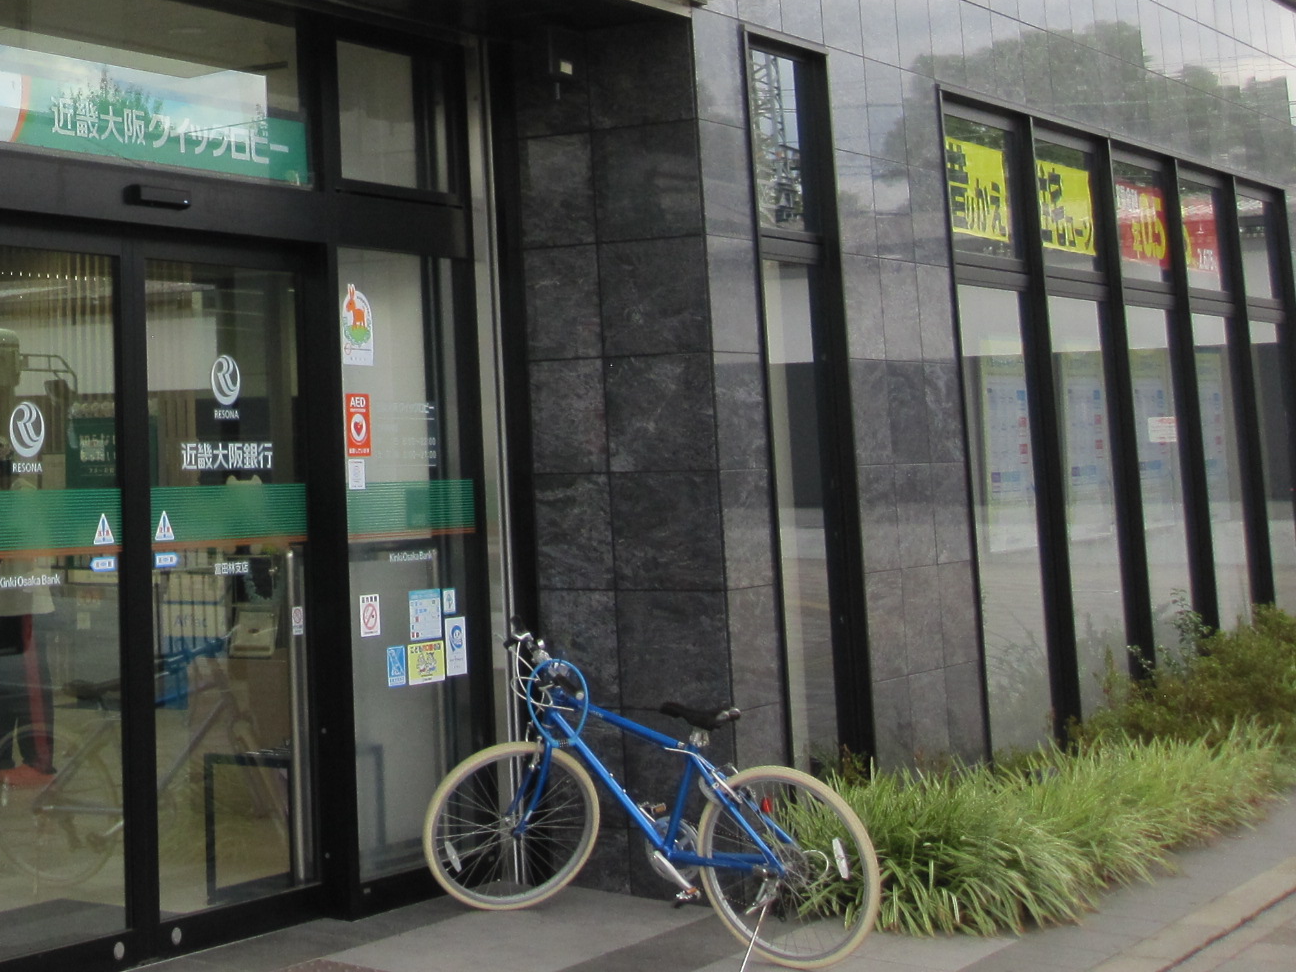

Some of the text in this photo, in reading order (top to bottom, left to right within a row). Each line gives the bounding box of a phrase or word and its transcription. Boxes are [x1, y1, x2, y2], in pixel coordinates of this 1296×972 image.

[349, 396, 366, 408] AED
[214, 409, 240, 420] RESONA
[181, 441, 274, 471] 近畿大阪銀行
[12, 462, 43, 474] RESONA
[214, 561, 249, 575] 富田林支店
[17, 575, 41, 587] Osaka
[41, 573, 61, 586] Bank
